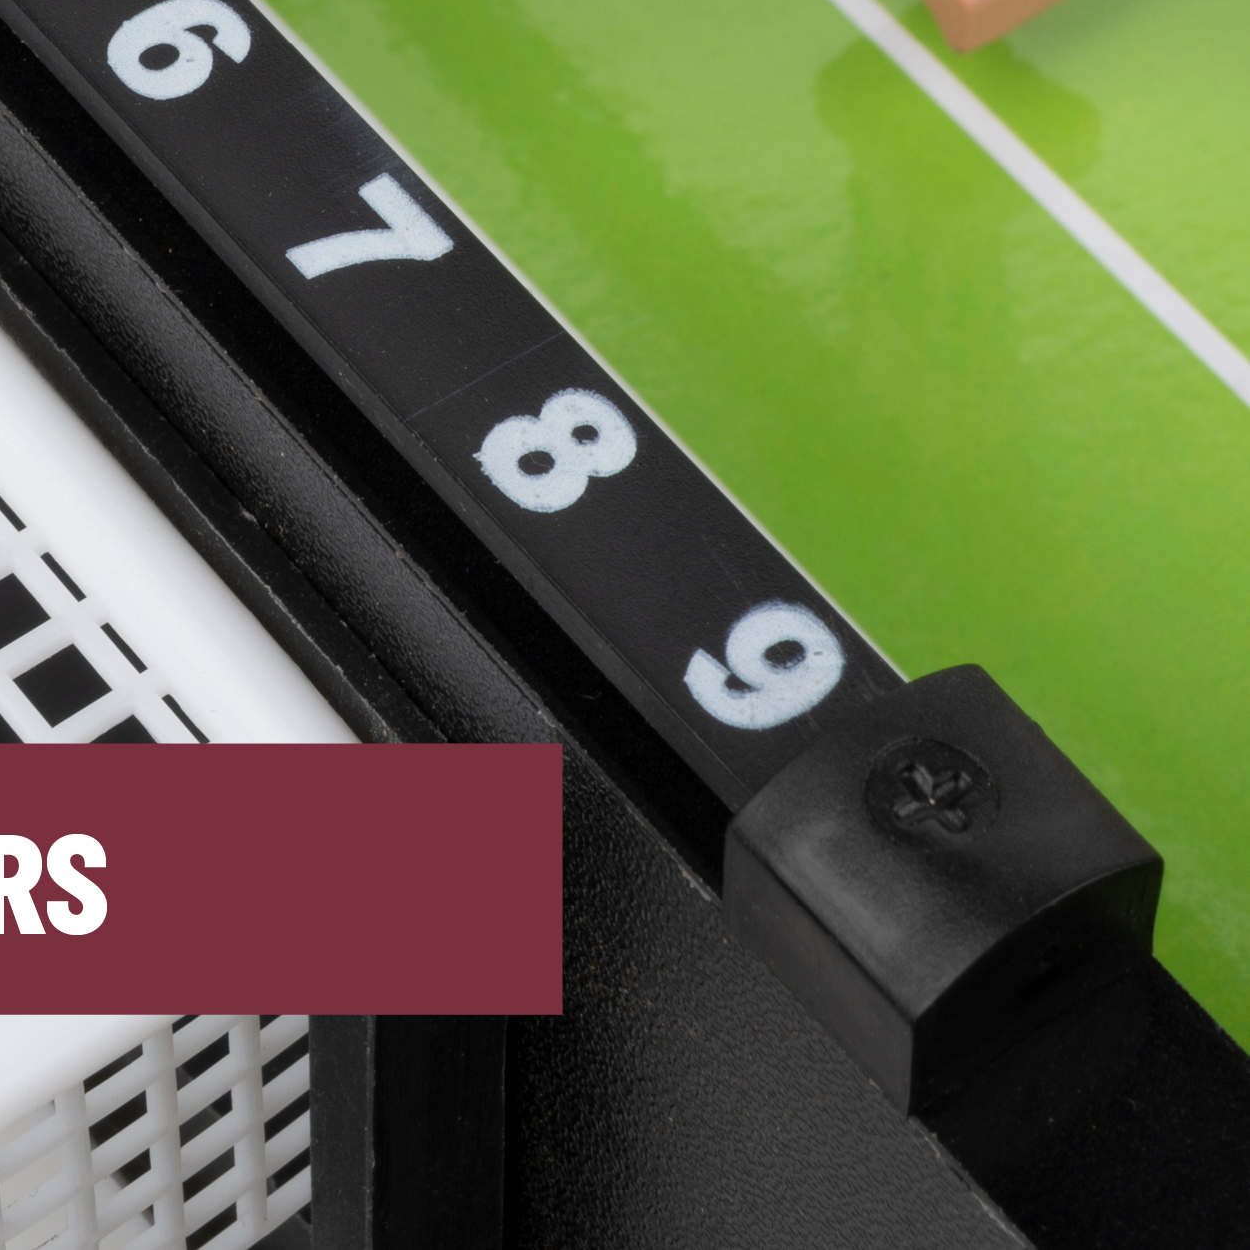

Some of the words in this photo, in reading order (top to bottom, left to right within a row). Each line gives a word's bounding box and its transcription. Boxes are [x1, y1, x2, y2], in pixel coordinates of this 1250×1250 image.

[285, 172, 454, 280] 7
[473, 387, 638, 513] 8
[683, 602, 846, 730] 9
